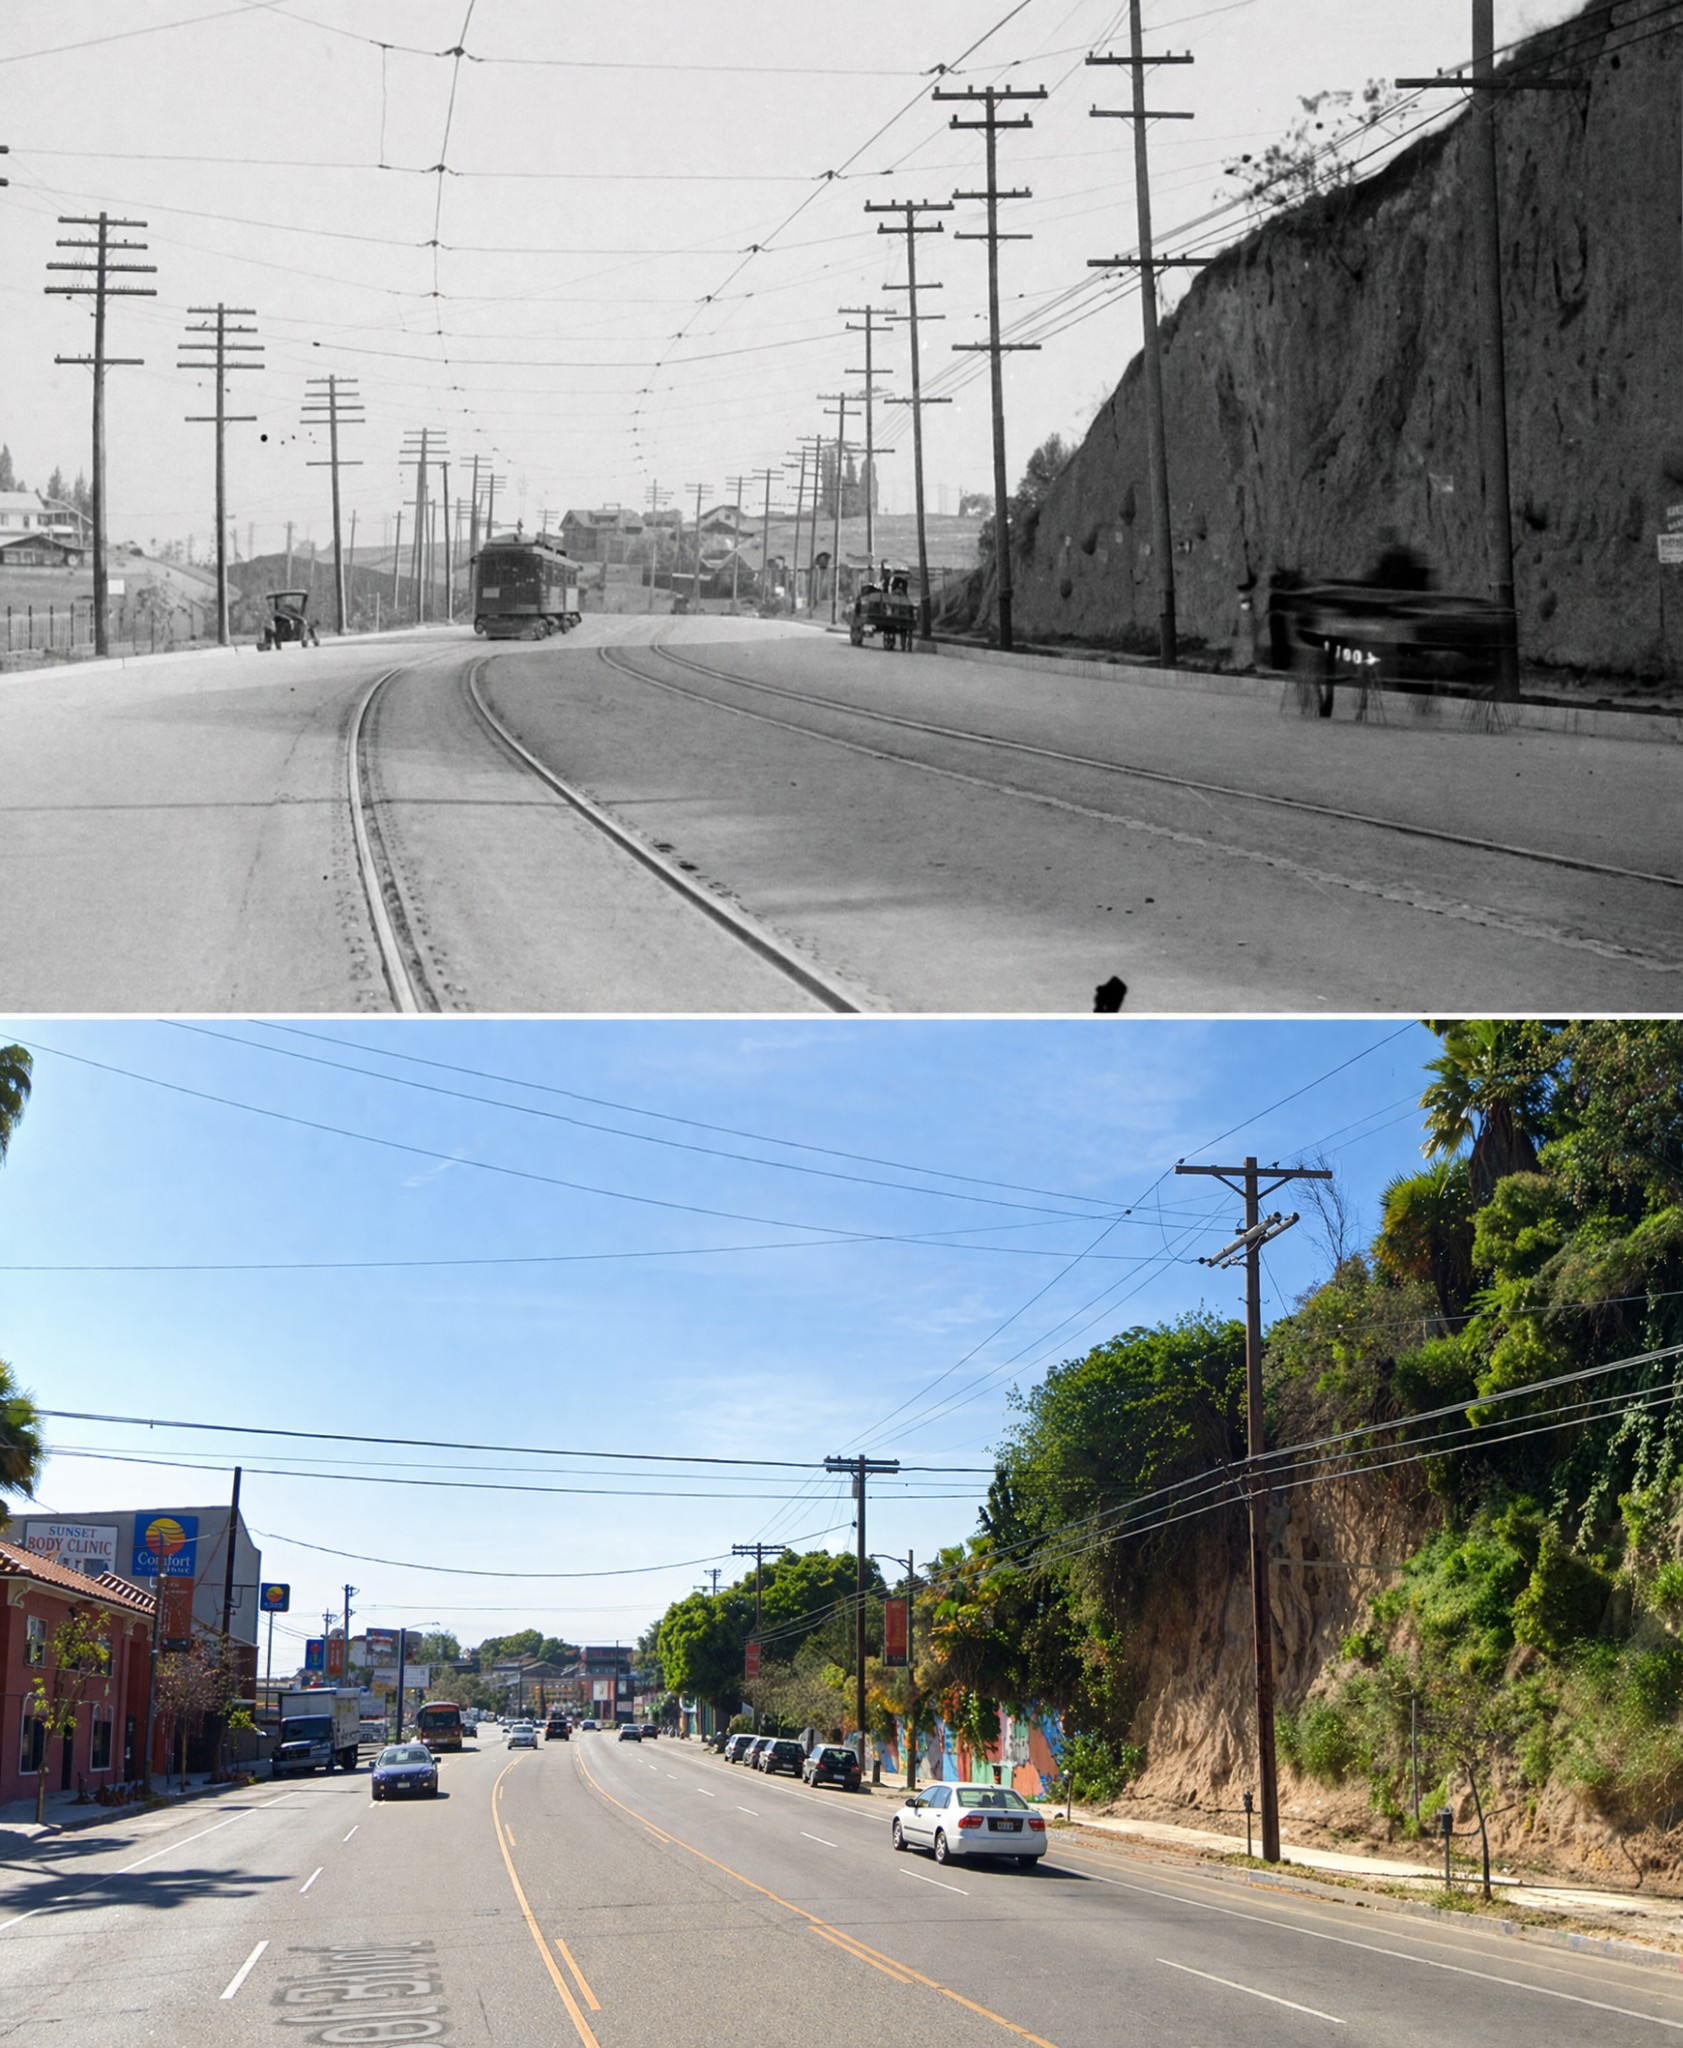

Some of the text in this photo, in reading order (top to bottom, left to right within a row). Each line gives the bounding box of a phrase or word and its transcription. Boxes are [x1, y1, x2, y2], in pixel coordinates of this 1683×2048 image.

[49, 1525, 98, 1539] SUNSET
[27, 1536, 112, 1556] BODY CLINIC
